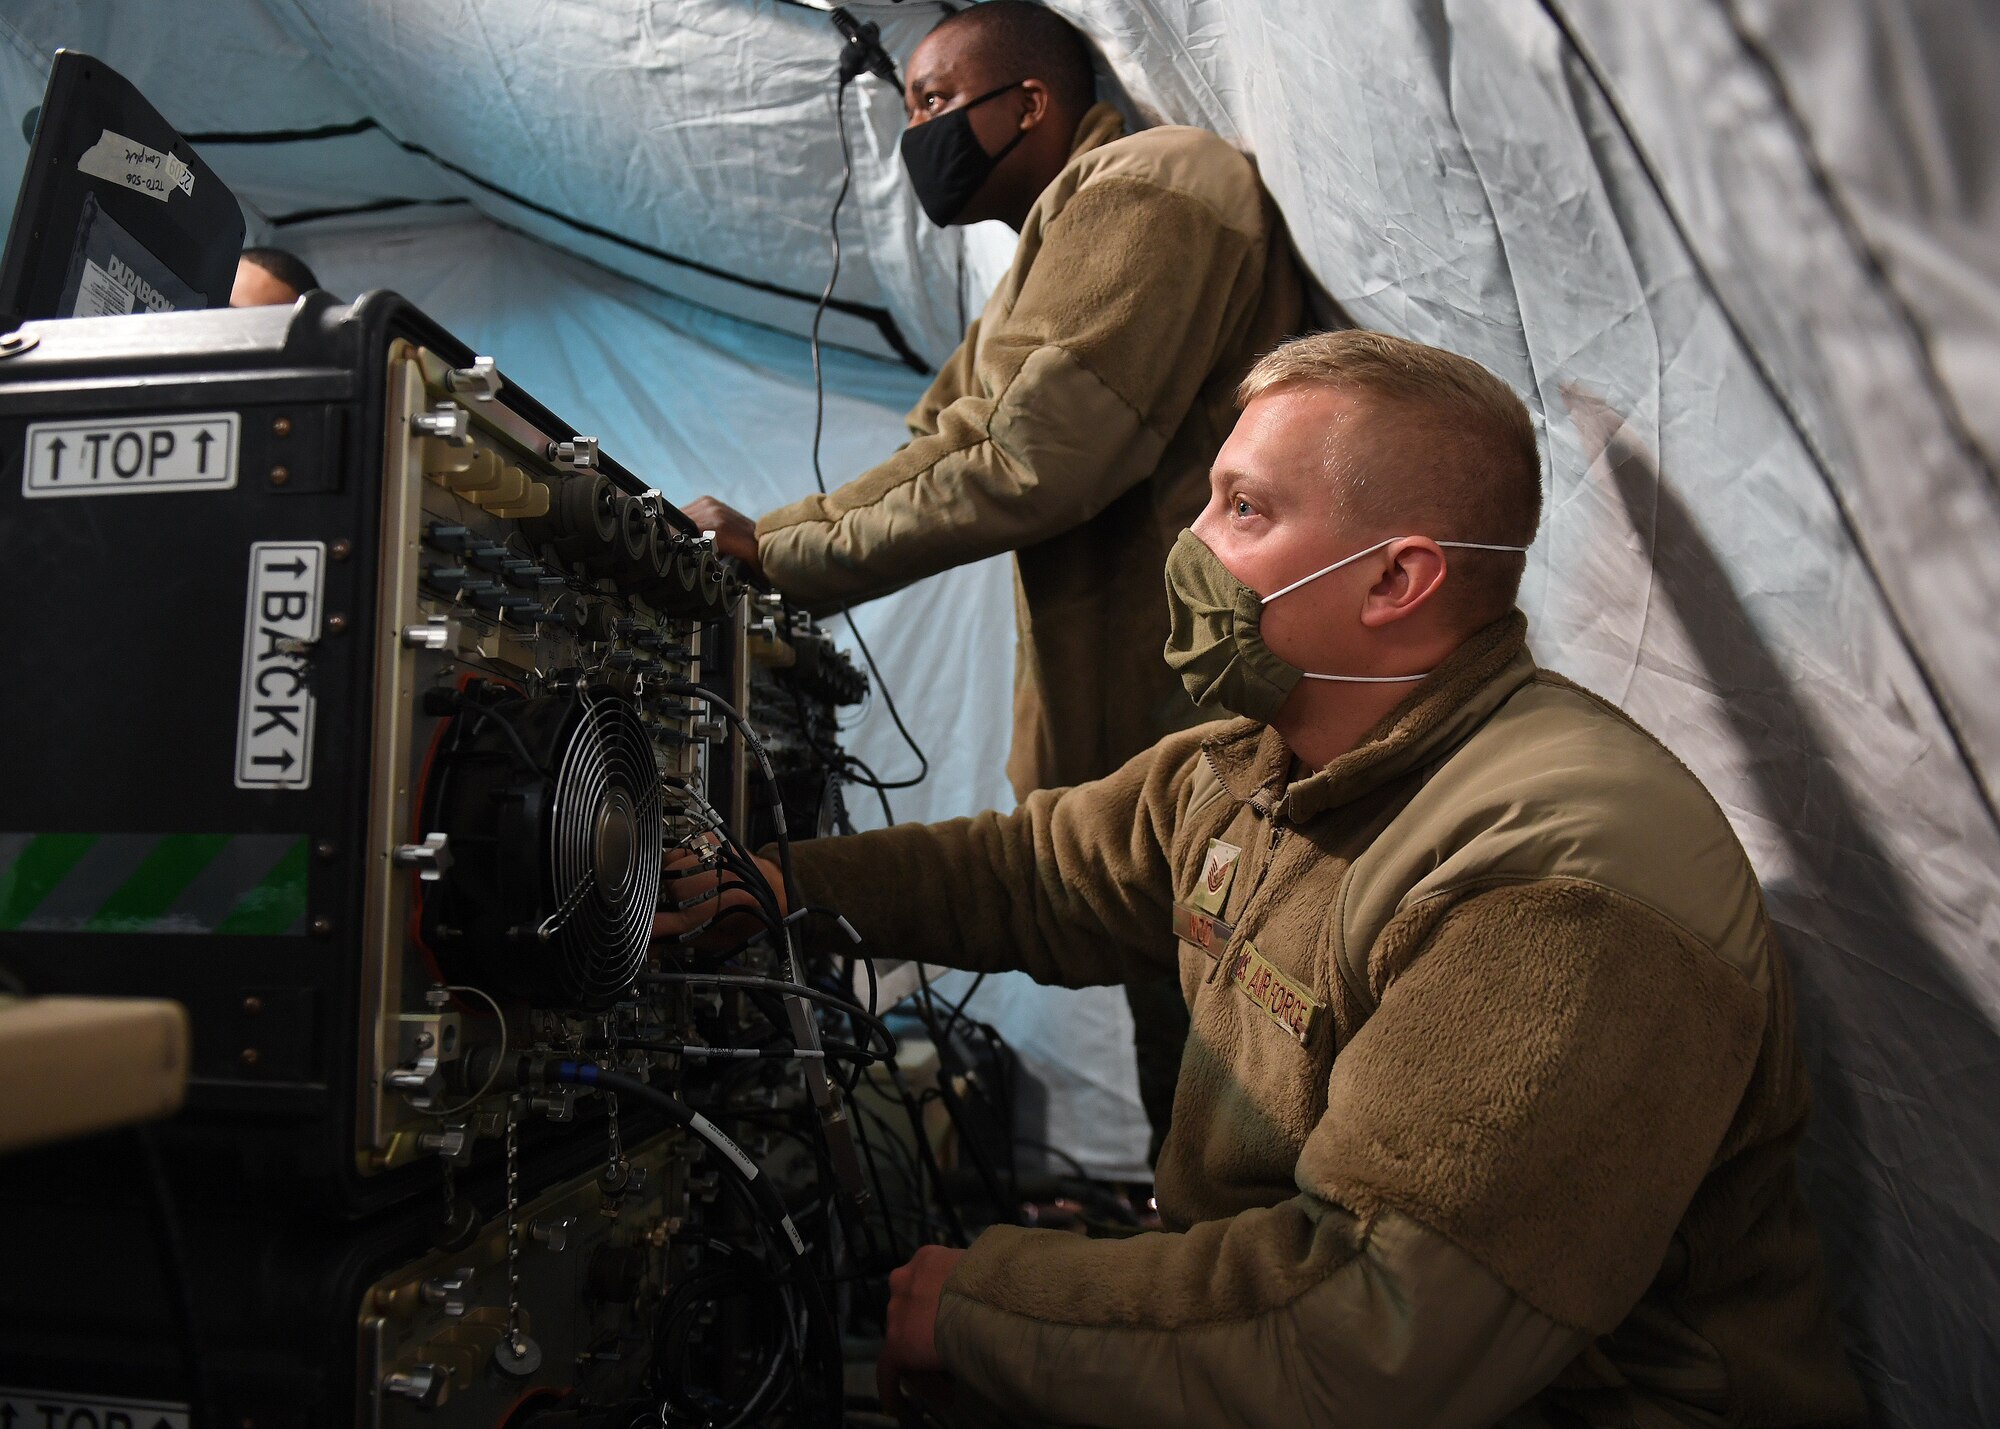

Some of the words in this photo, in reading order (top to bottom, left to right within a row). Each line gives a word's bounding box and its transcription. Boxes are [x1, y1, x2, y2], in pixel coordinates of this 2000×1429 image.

[83, 430, 176, 480] TOP
[253, 590, 307, 737] BACK
[1246, 963, 1273, 1002] AIR
[1266, 976, 1308, 1035] FORCE
